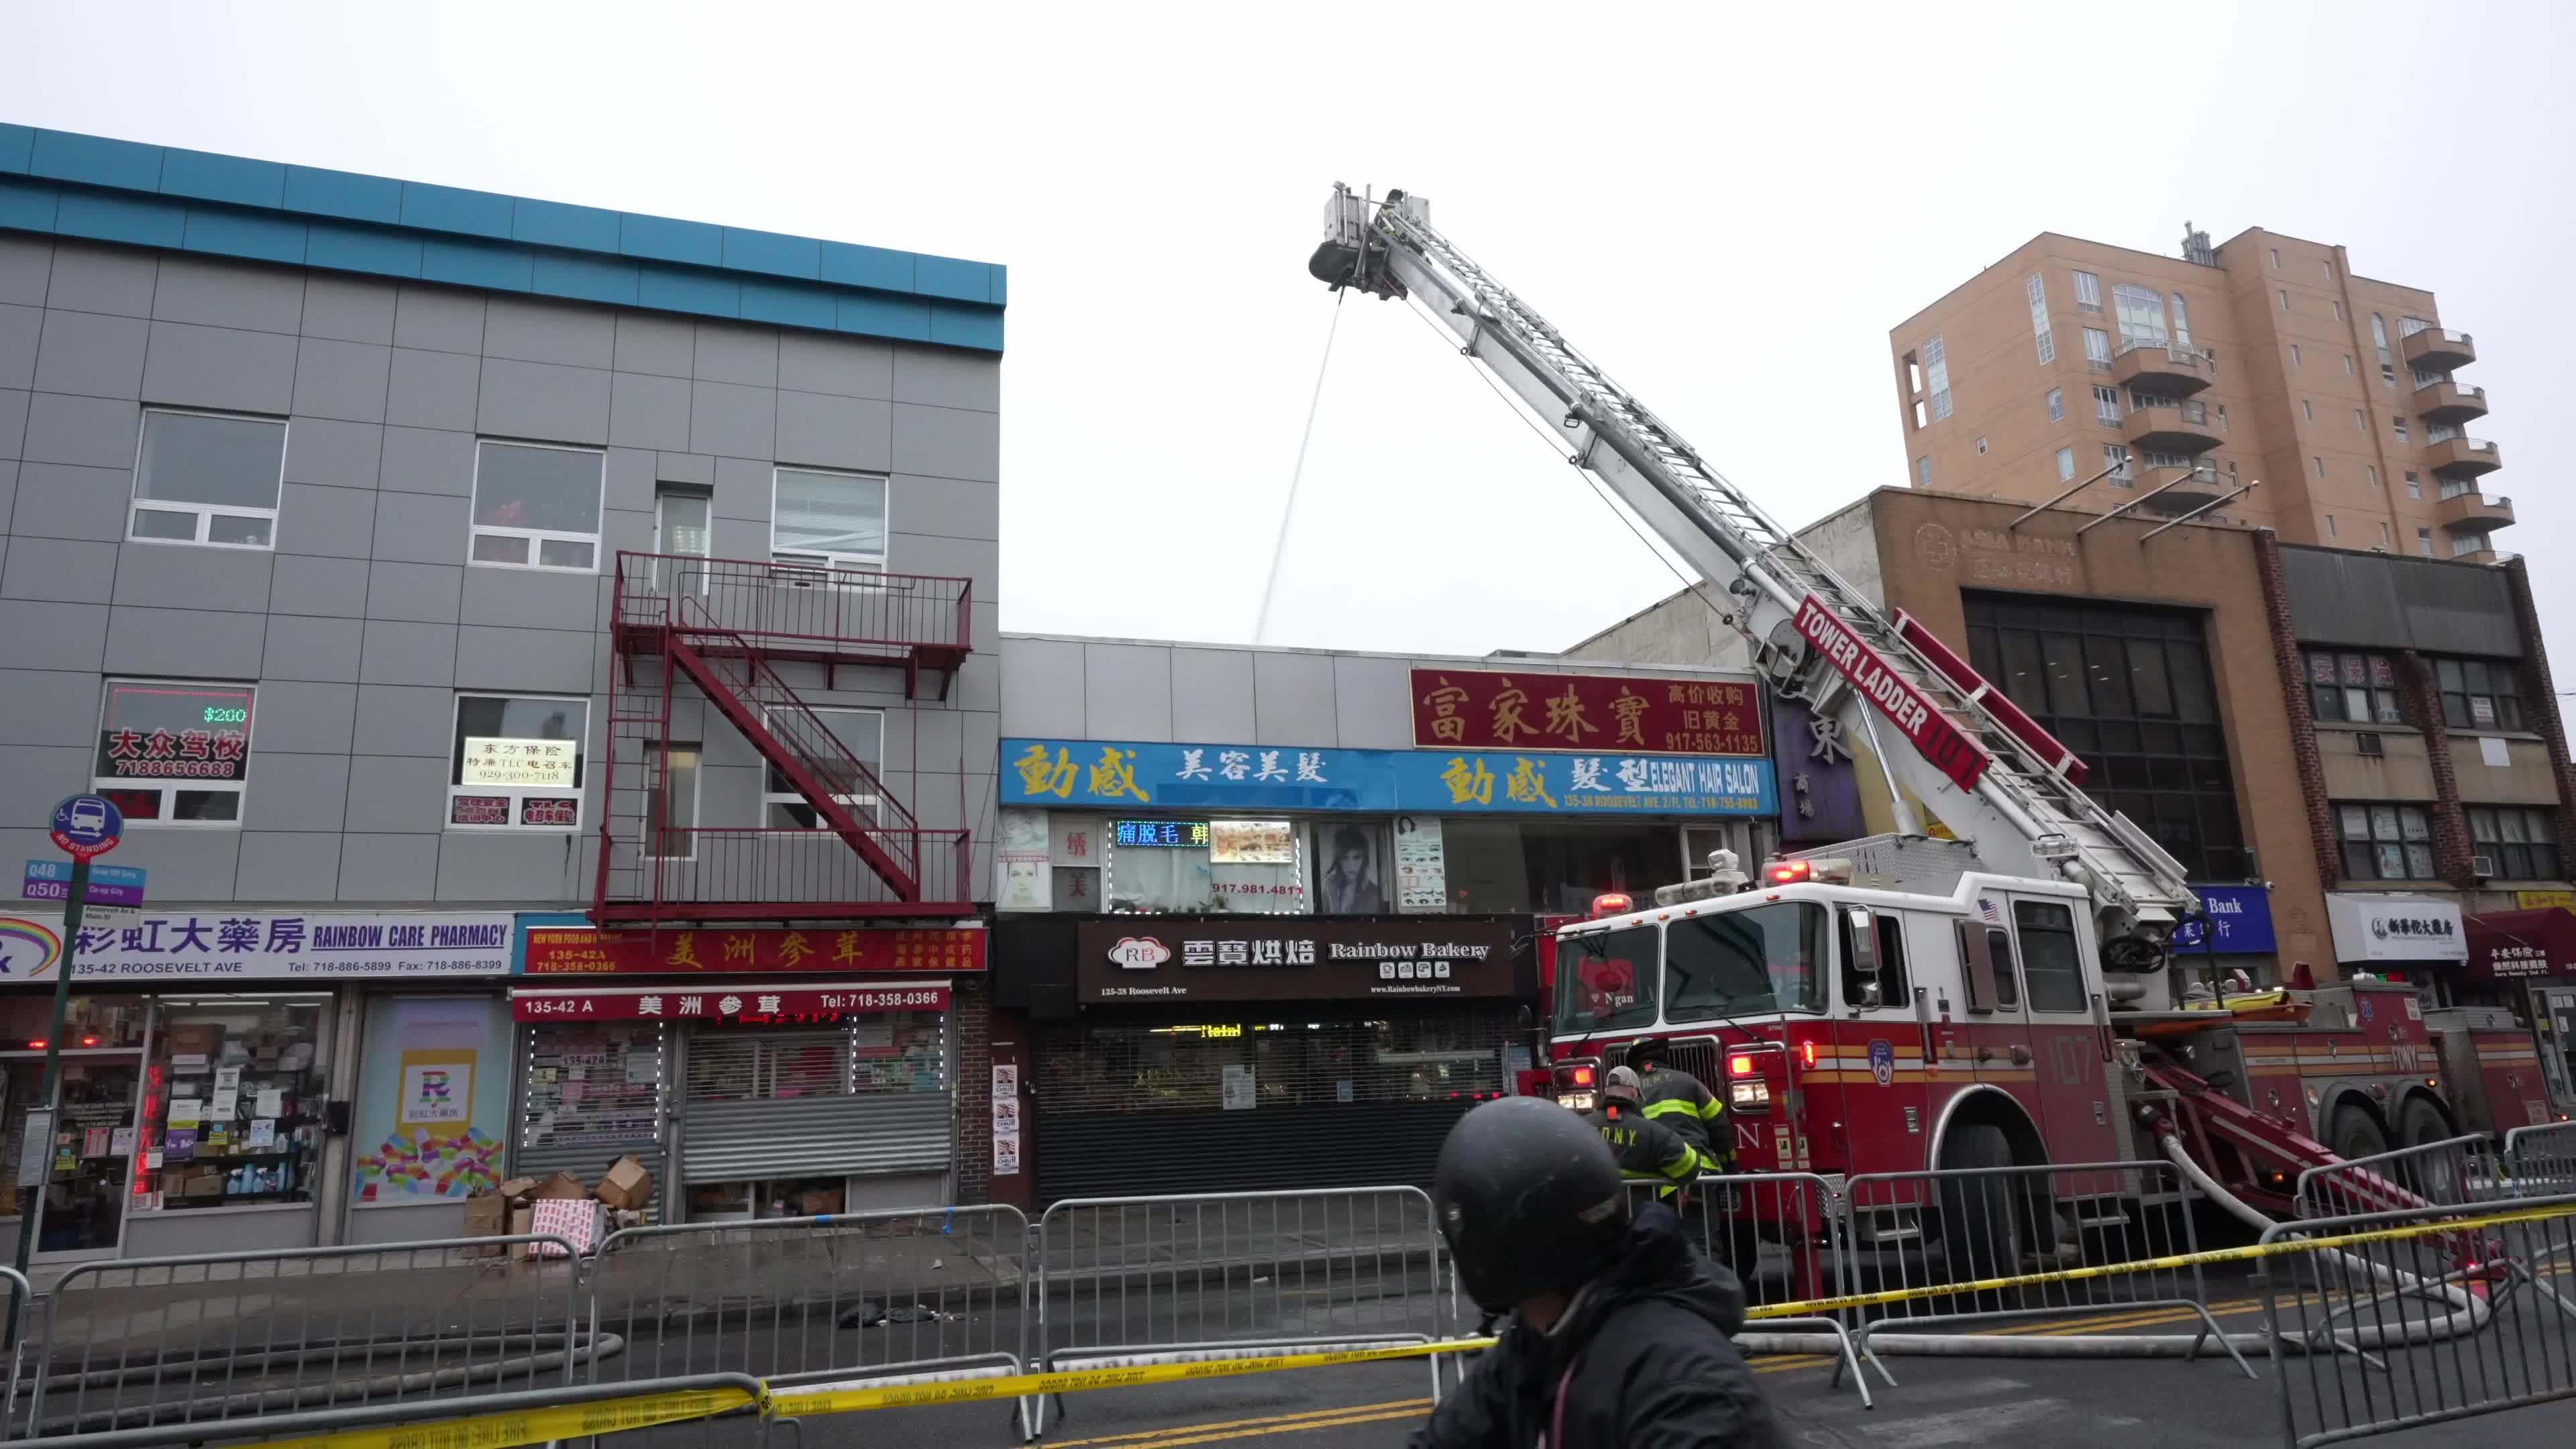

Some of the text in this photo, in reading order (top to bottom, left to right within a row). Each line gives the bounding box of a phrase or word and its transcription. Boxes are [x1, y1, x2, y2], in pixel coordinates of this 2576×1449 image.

[1799, 602, 1860, 671] TOWER
[1853, 655, 1929, 736] LADDER
[1668, 684, 1744, 706] 高价收购
[1424, 676, 1650, 746] 富家珠寶
[1684, 710, 1740, 732] 旧黄金
[108, 727, 245, 760] 大众驾校
[483, 743, 561, 756] 东方保险
[1666, 734, 1758, 753] 917-563-1135
[115, 759, 235, 777] 7188656688
[1014, 745, 1149, 802] 動感
[1176, 749, 1328, 782] 美容美髮
[1570, 757, 1652, 792] 髮型
[1440, 756, 1557, 809] 動感
[1650, 761, 1760, 795] ELEGANT HAIR SALON
[57, 833, 115, 854] NO STANDING
[1118, 823, 1179, 844] 痛脱毛
[29, 863, 56, 877] Q48
[27, 882, 60, 897] Q50
[2208, 898, 2243, 914] Bank
[72, 918, 307, 955] 彩虹大藥房
[313, 924, 508, 948] RAINBOW CARE PHARMACY
[533, 933, 547, 945] NEW
[548, 950, 606, 960] 135-42A
[665, 931, 864, 969] 美洲參茸
[1126, 947, 1155, 961] RB
[1183, 939, 1316, 966] 雲寶烘焙
[1329, 942, 1491, 961] Rainbow Bakery
[70, 962, 243, 975] 135-42 ROOSEVELT AVE
[288, 960, 502, 972] Tel: 718-886-5899 Fax: 718-886-8399
[537, 961, 616, 972] 718-358-0366
[821, 992, 938, 1008] Tel: 718-358-0366
[1102, 987, 1127, 996] 135-38
[1129, 987, 1170, 995] Roosevelt
[525, 1000, 594, 1014] 135-42 A
[639, 995, 782, 1014] 美洲參茸
[2047, 1035, 2093, 1084] 107
